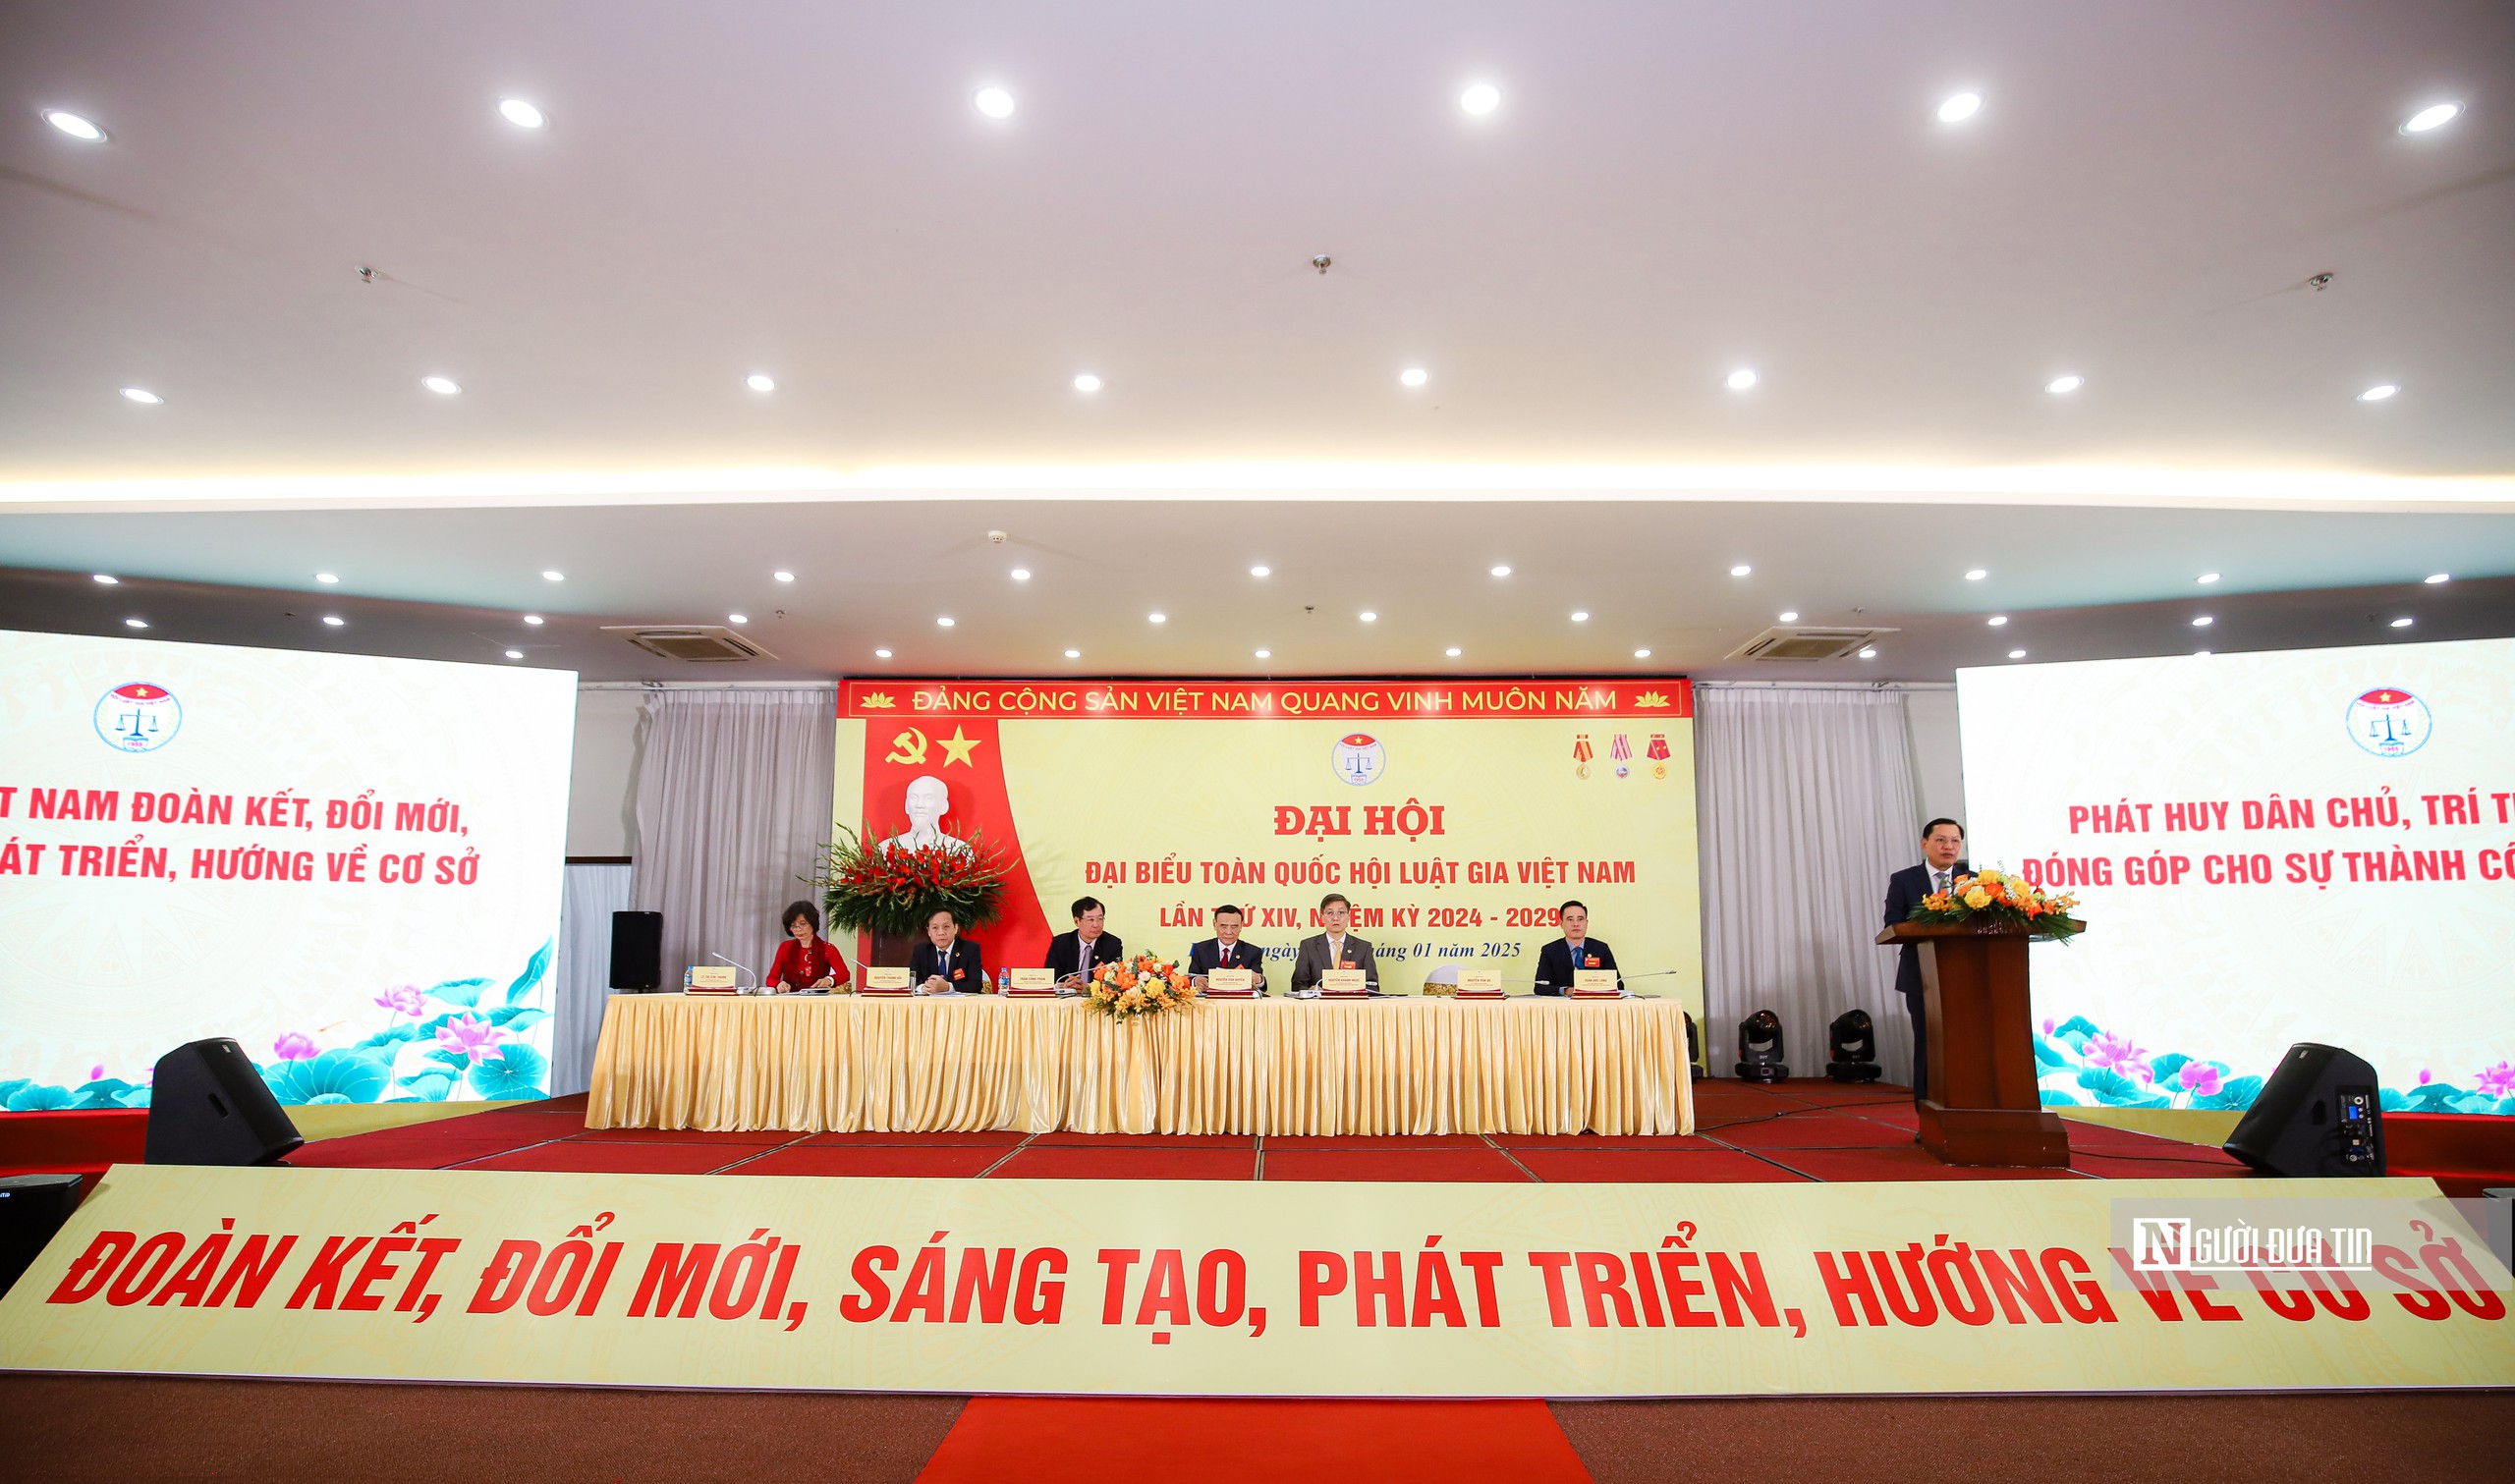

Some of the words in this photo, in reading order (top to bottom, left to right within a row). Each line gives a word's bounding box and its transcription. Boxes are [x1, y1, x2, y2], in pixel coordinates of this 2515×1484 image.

[912, 686, 990, 710] ĐẢNG
[998, 687, 1077, 715] CỘNG
[1085, 686, 1139, 711] SẢN
[1146, 687, 1204, 716] VIỆT
[1211, 691, 1272, 711] NAM
[1280, 691, 1379, 714] QUANG
[1387, 691, 1452, 711] VINH
[1462, 687, 1546, 710] MUÔN
[1555, 686, 1617, 710] NĂM
[0, 787, 18, 817] T
[28, 788, 119, 821] NAM
[131, 787, 233, 825] ĐOÀN
[245, 788, 312, 832] KẾT,
[326, 789, 383, 830] ĐỔI
[395, 797, 468, 837] MỚI,
[1273, 805, 1351, 843] ĐẠI
[1364, 797, 1445, 843] HỘI
[2069, 797, 2152, 834] PHÁT
[2164, 801, 2229, 832] HUY
[2242, 793, 2315, 830] DÂN
[2326, 786, 2411, 831] CHỦ,
[2421, 787, 2480, 826] TRÍ
[0, 836, 46, 876] ÁT
[58, 833, 177, 882] TRIỂN,
[191, 844, 313, 881] HƯỚNG
[326, 844, 368, 882] VỀ
[378, 852, 425, 884] CƠ
[434, 846, 480, 885] SỞ
[1085, 861, 1127, 889] ĐẠI
[1136, 852, 1192, 884] BIỂU
[1200, 857, 1265, 884] TOÀN
[1274, 853, 1341, 886] QUỐC
[1350, 856, 1390, 889] HỘI
[1399, 856, 1459, 889] LUẬT
[1468, 860, 1509, 884] GIA
[1517, 856, 1569, 889] VIỆT
[1578, 860, 1636, 884] NAM
[2022, 851, 2112, 887] ĐÓNG
[2124, 849, 2191, 886] GÓP
[2203, 853, 2272, 885] CHO
[2284, 850, 2334, 890] SỰ
[2342, 844, 2466, 883] THÀNH
[1160, 901, 1203, 927] LẦN
[1260, 907, 1302, 930] XIV,
[1310, 904, 1383, 932] NỆM
[1392, 904, 1421, 927] KỲ
[1427, 907, 1482, 927] 2024
[1506, 907, 1560, 927] 2029
[1372, 942, 1407, 962] áng
[1413, 942, 1431, 958] 01
[1437, 943, 1475, 958] năm
[1480, 942, 1522, 958] 2025
[45, 1217, 298, 1309] ĐOÀN
[284, 1213, 462, 1324] KẾT,
[466, 1211, 625, 1317] ĐỔI
[626, 1228, 809, 1332] MỚI,
[838, 1231, 1069, 1326] SÁNG
[1096, 1247, 1267, 1346] TẠO,
[1298, 1235, 1504, 1329] PHÁT
[1528, 1221, 1808, 1339] TRIỂN,
[1813, 1234, 2119, 1329] HƯỚNG
[2365, 1220, 2507, 1322] SỞ
